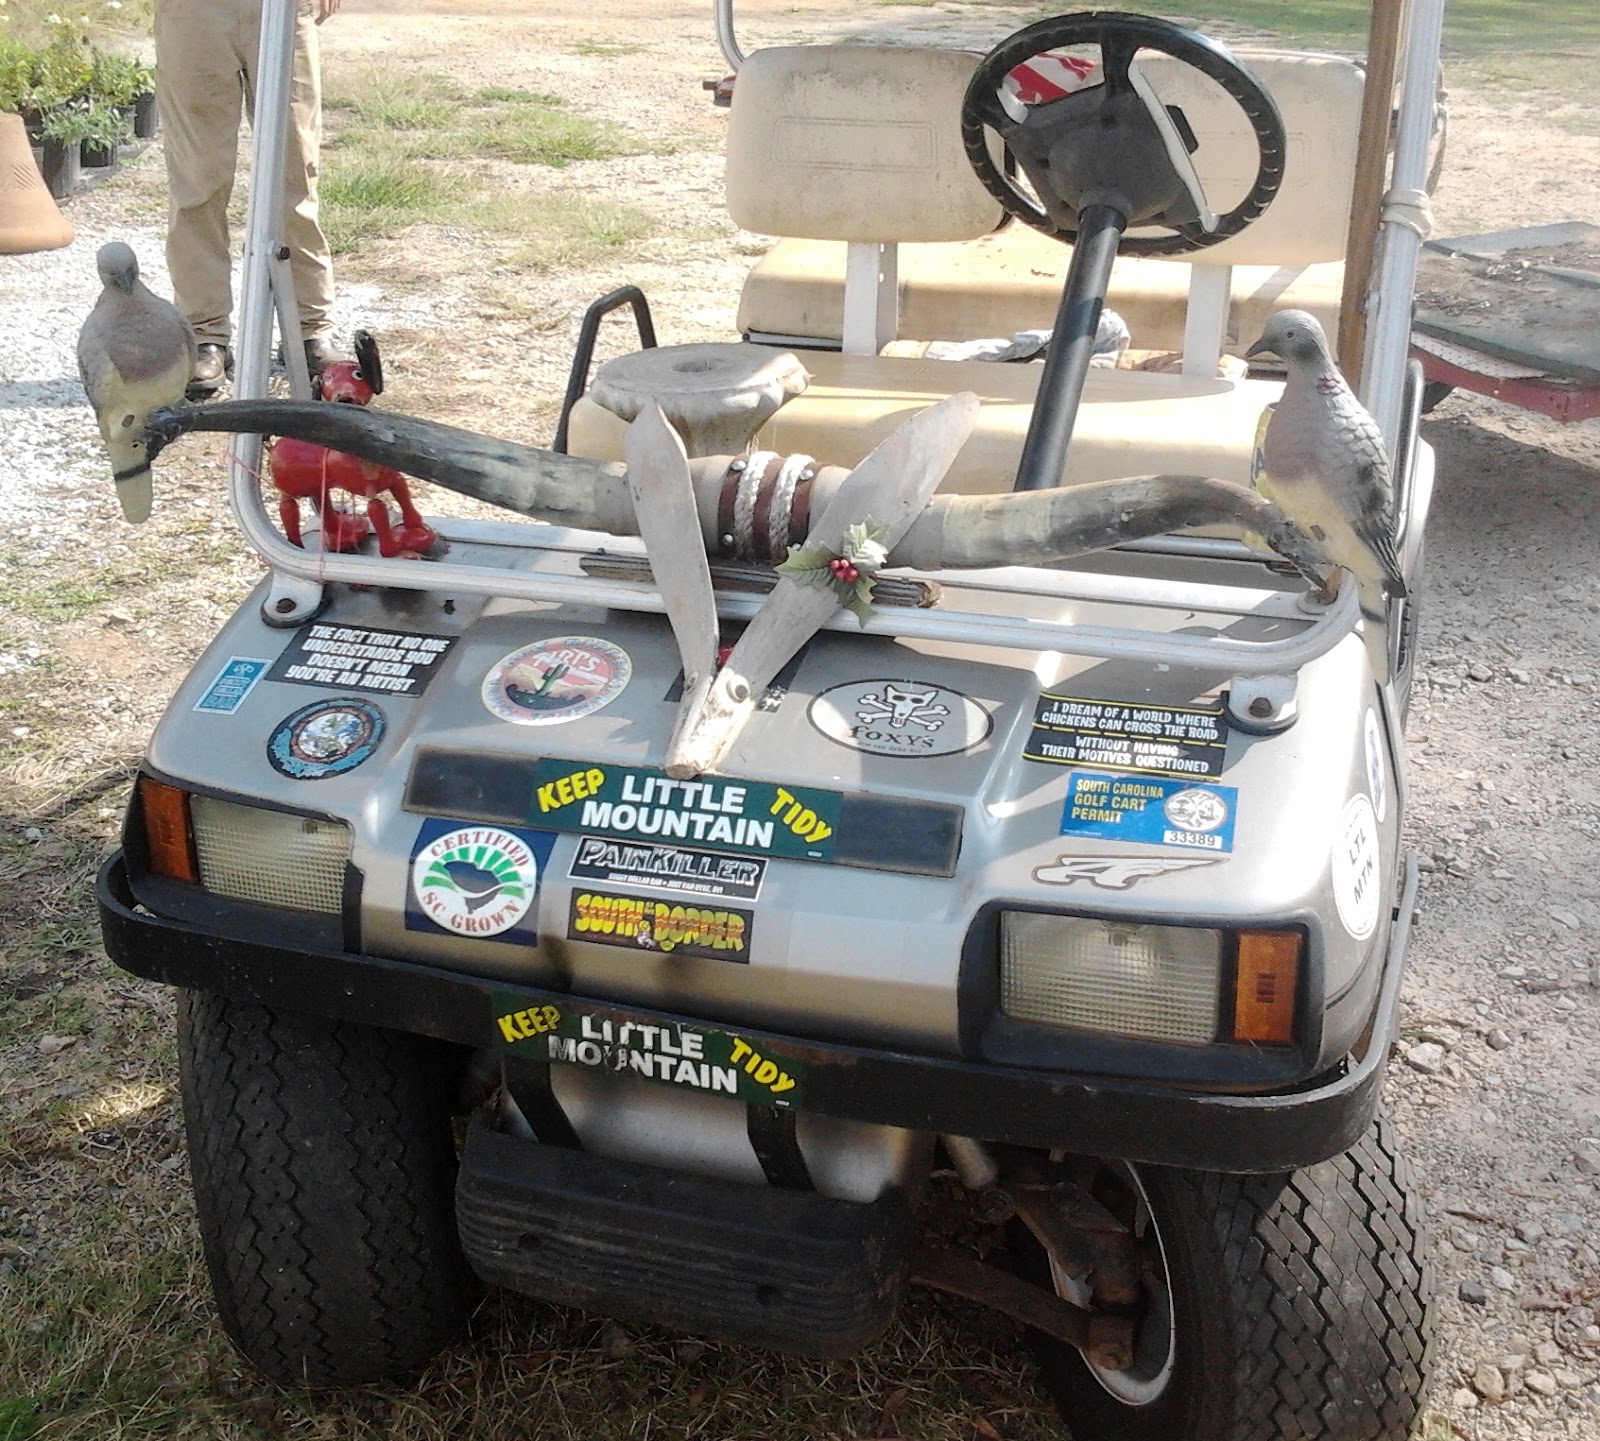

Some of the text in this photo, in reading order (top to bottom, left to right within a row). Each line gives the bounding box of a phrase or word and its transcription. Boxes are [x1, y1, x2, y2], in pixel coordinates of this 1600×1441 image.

[302, 638, 437, 665] UNDERSTANDS YOU
[309, 625, 450, 653] THE FACT THAT NO ONE
[283, 665, 416, 692] YOU'RE AN ARTIST
[307, 653, 413, 677] DOESN'T MEAN
[1041, 711, 1219, 740] CHICKENS CAN CROSS THE ROAD
[1052, 701, 1217, 728] I DREAM OF A WORLD WHERE
[1041, 743, 1210, 773] THEIR MOTIVES QUESTIONED
[1075, 735, 1180, 757] WITHOUT HAVING
[536, 768, 605, 813] KEEP
[621, 774, 747, 814] LITTLE
[1074, 793, 1149, 811] GOLF CART
[1076, 779, 1164, 799] SOUTH CAROLINA
[580, 800, 774, 849] MOUNTAIN
[769, 787, 832, 844] TIDY
[1071, 807, 1124, 823] PERMIT
[430, 830, 530, 868] CERTIFIED
[1169, 832, 1216, 847] 33389
[1349, 828, 1366, 866] LTL
[578, 839, 760, 886] PAINKILLER
[1354, 853, 1373, 904] MTN
[422, 891, 521, 933] SC GROWN
[575, 893, 645, 937] SOUTH
[653, 902, 746, 952] BORDER
[496, 1004, 561, 1043] KEEP
[581, 1011, 705, 1061] LITTLE
[729, 1037, 797, 1093] TIDY
